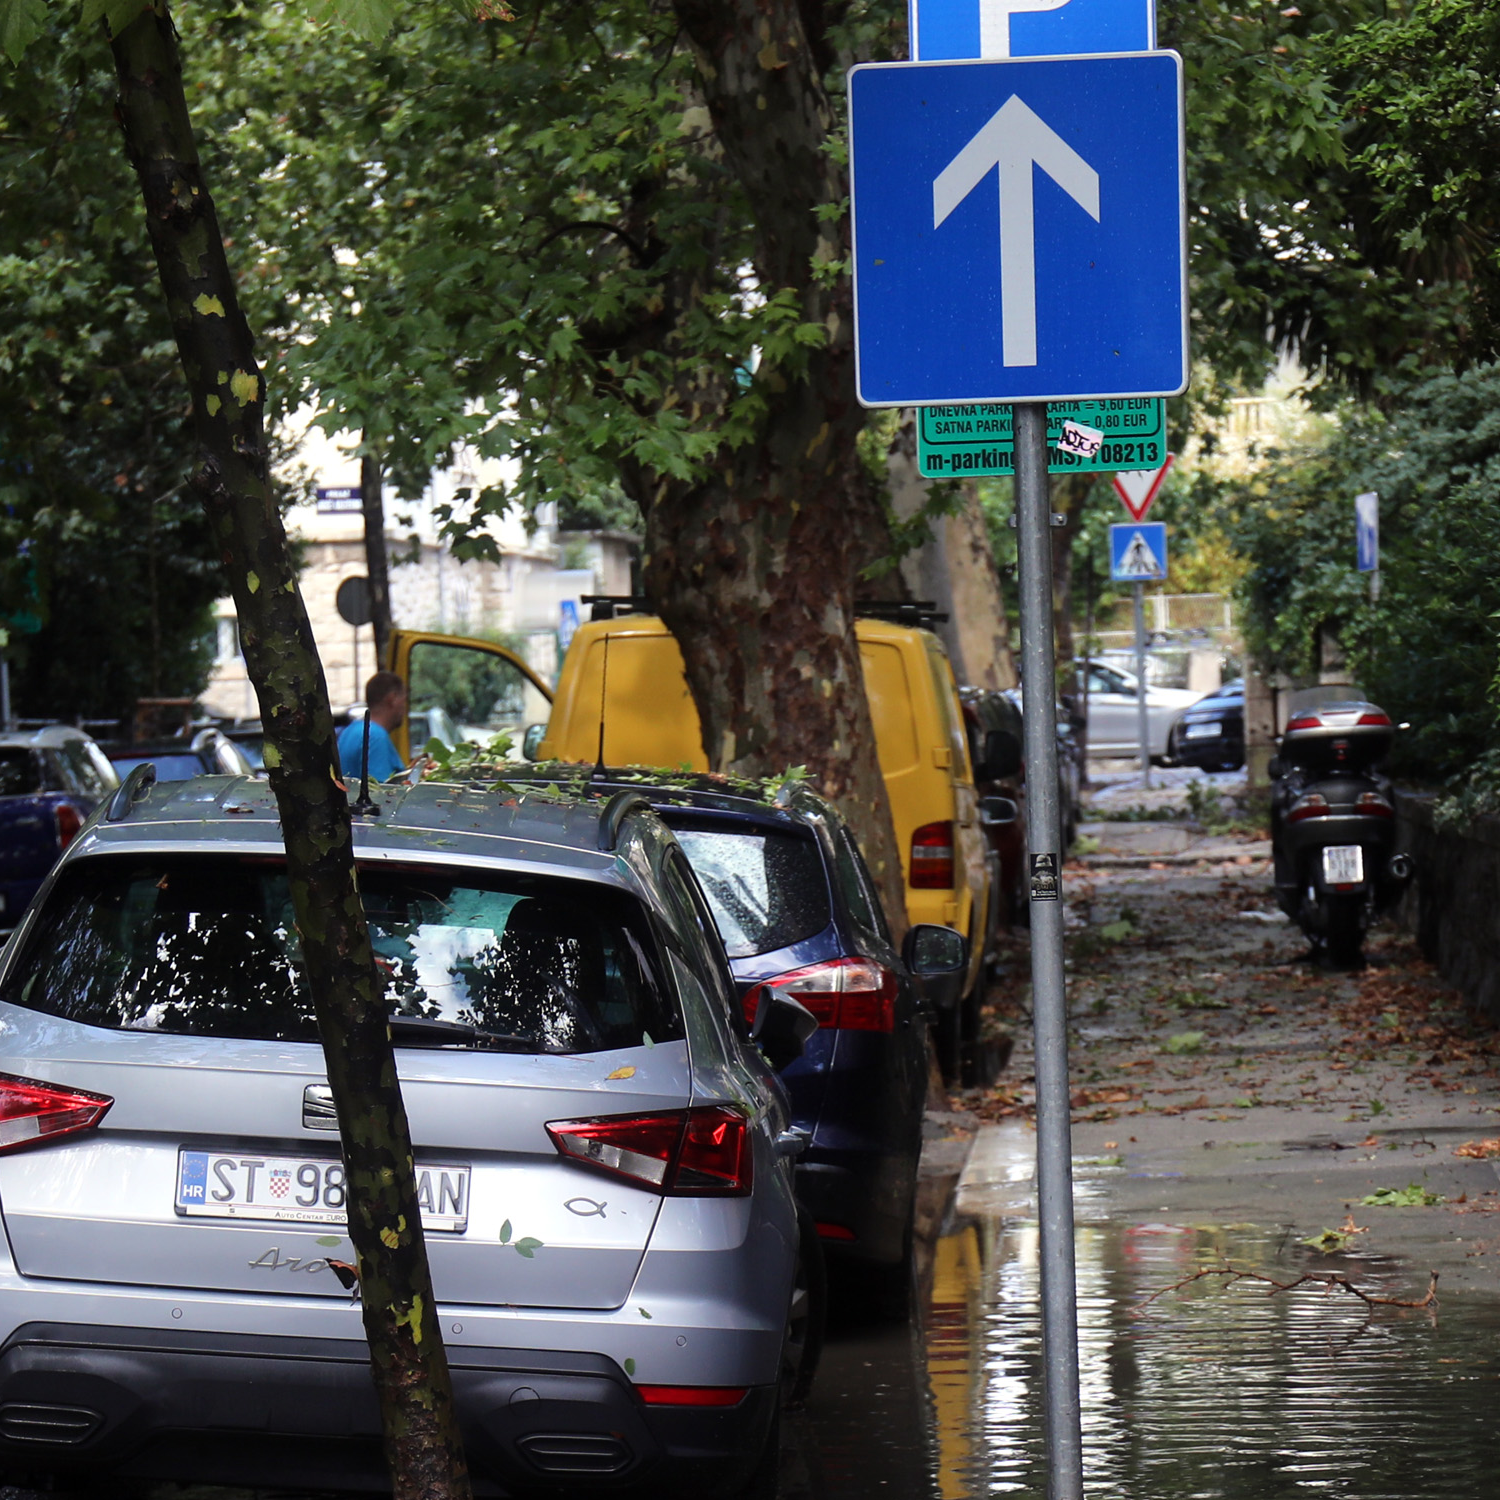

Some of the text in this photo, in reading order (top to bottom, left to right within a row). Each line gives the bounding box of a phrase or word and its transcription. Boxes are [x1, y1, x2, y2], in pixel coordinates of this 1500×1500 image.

[930, 405, 977, 417] DNEVNA
[981, 403, 1013, 415] PARK
[1128, 397, 1151, 410] EUR
[935, 420, 973, 434] SATNA
[976, 418, 1013, 433] PARKI
[1094, 415, 1119, 429] 0,80
[1123, 413, 1147, 427] EUR
[182, 1184, 204, 1199] HR
[210, 1158, 265, 1204] ST
[295, 1163, 347, 1208] 98
[248, 1246, 329, 1274] Aro
